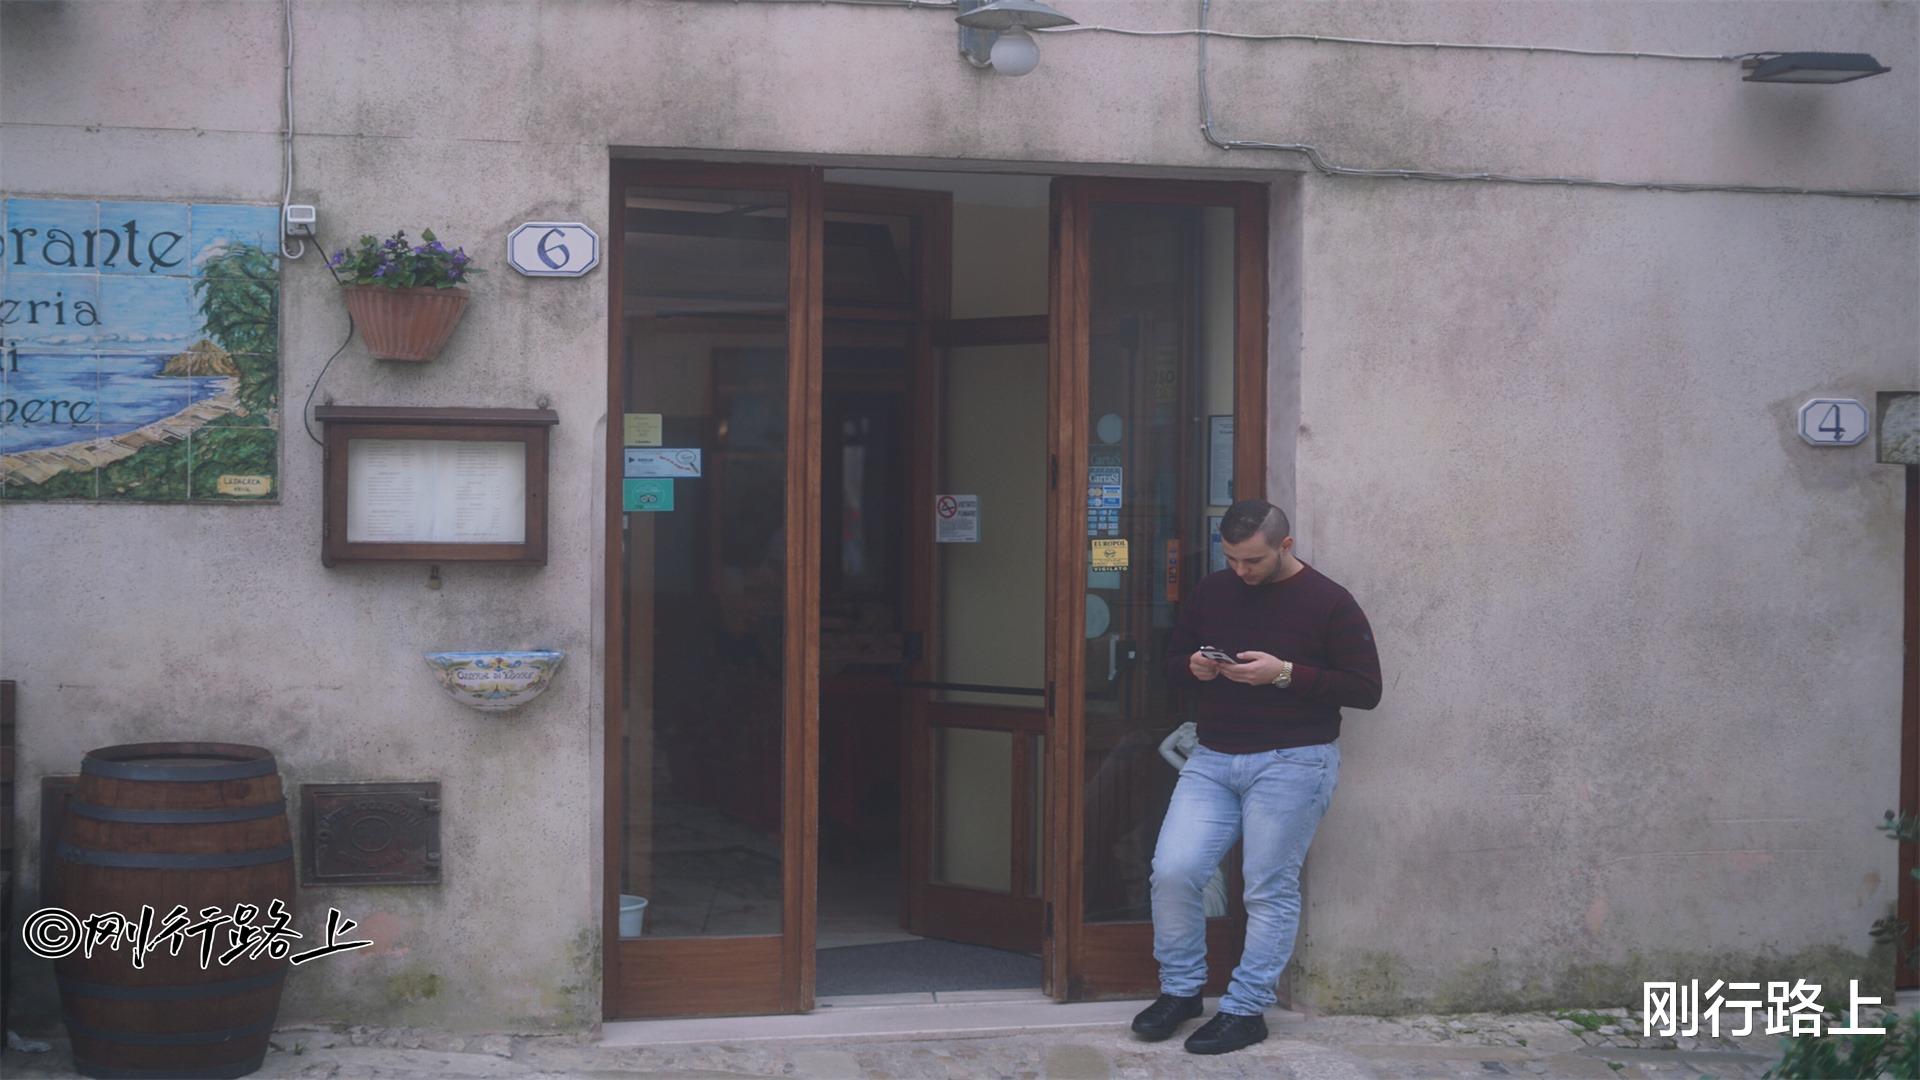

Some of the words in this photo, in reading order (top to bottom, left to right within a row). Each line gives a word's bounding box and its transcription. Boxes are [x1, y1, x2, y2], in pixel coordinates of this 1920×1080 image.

[0, 218, 185, 273] rante
[537, 228, 570, 270] 6
[1818, 404, 1846, 441] 4
